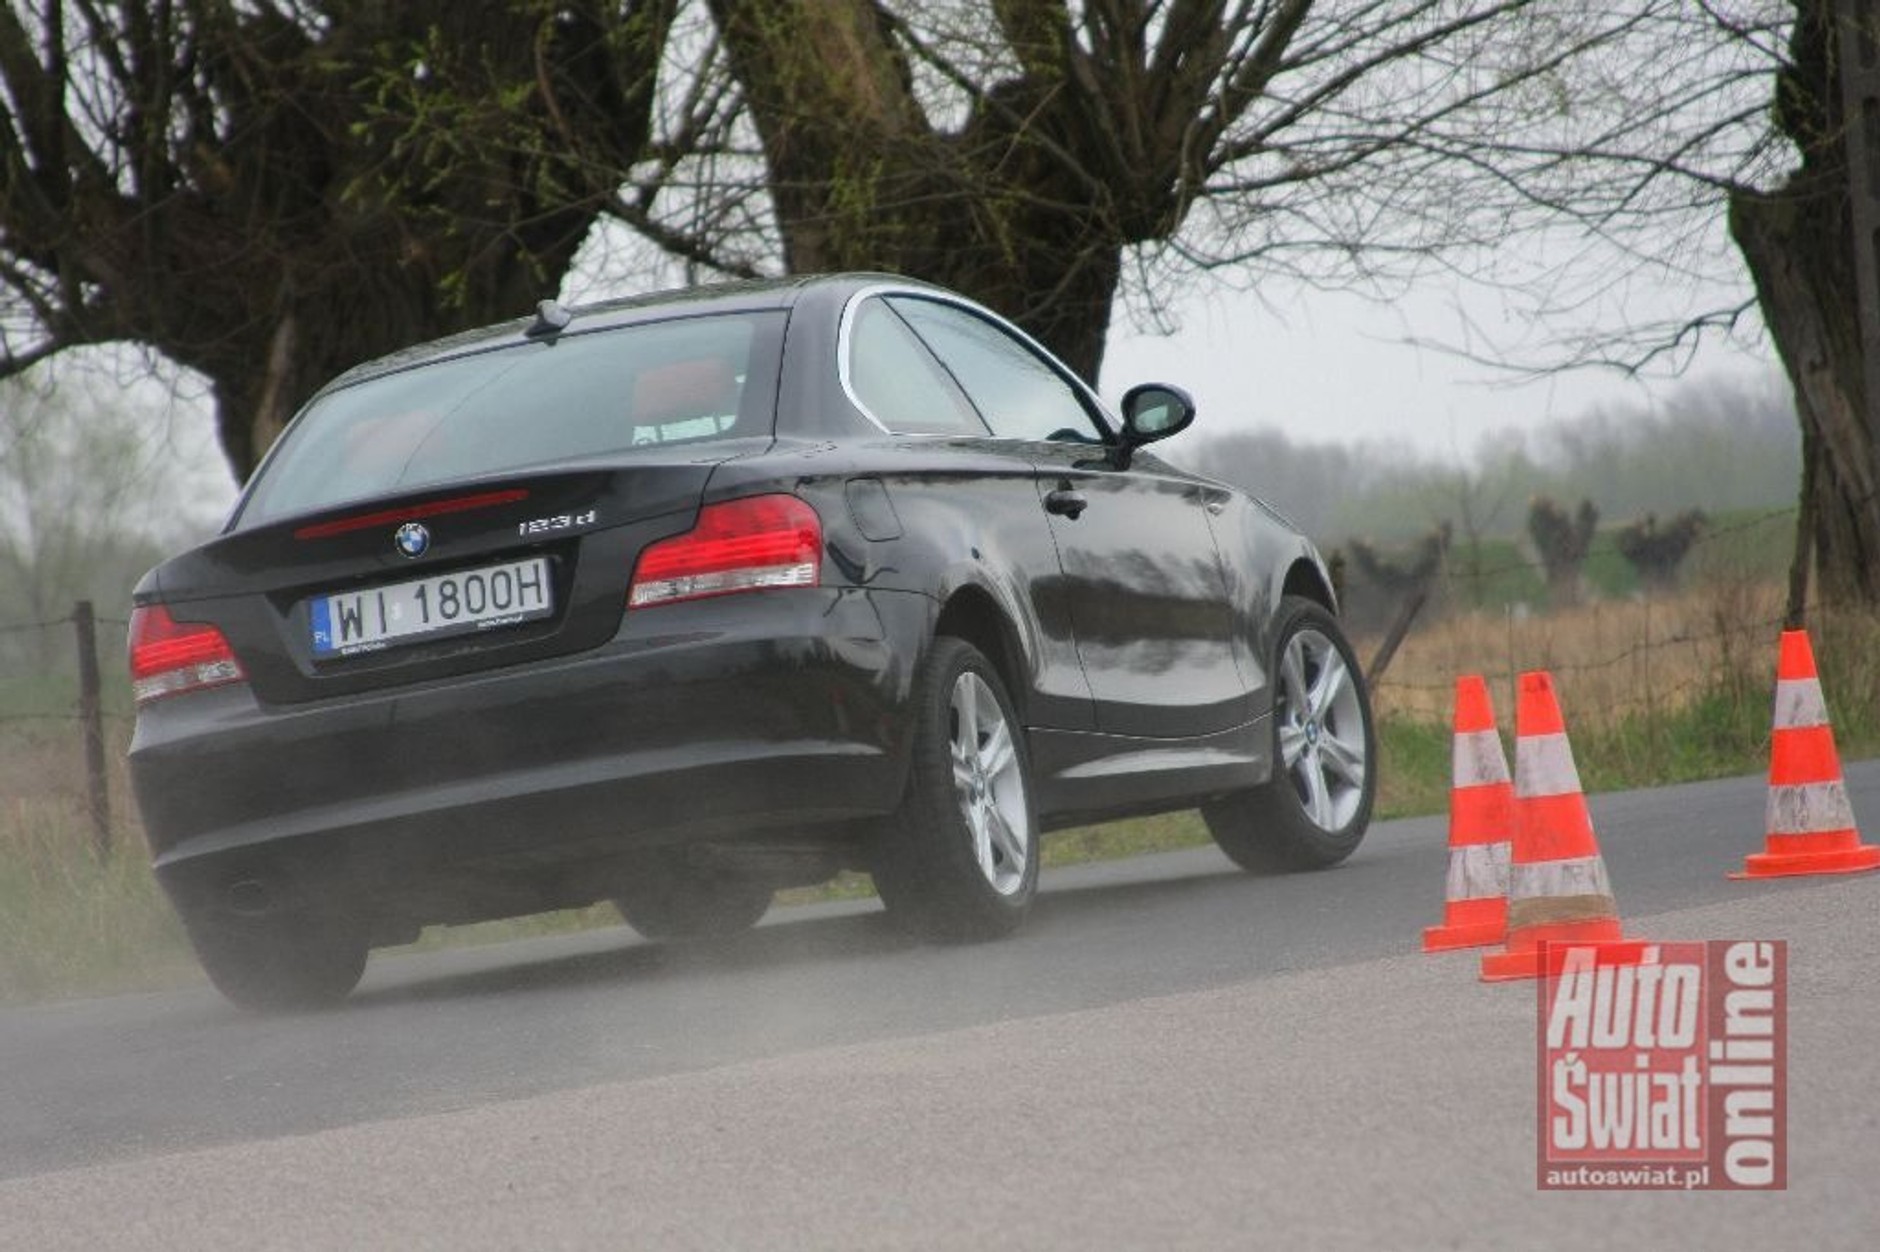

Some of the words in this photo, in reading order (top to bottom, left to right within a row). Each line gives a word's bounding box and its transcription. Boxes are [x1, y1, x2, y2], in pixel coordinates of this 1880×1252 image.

[519, 510, 596, 537] 123d
[337, 591, 388, 642] WI
[414, 563, 543, 624] 1800H
[314, 630, 330, 644] PL
